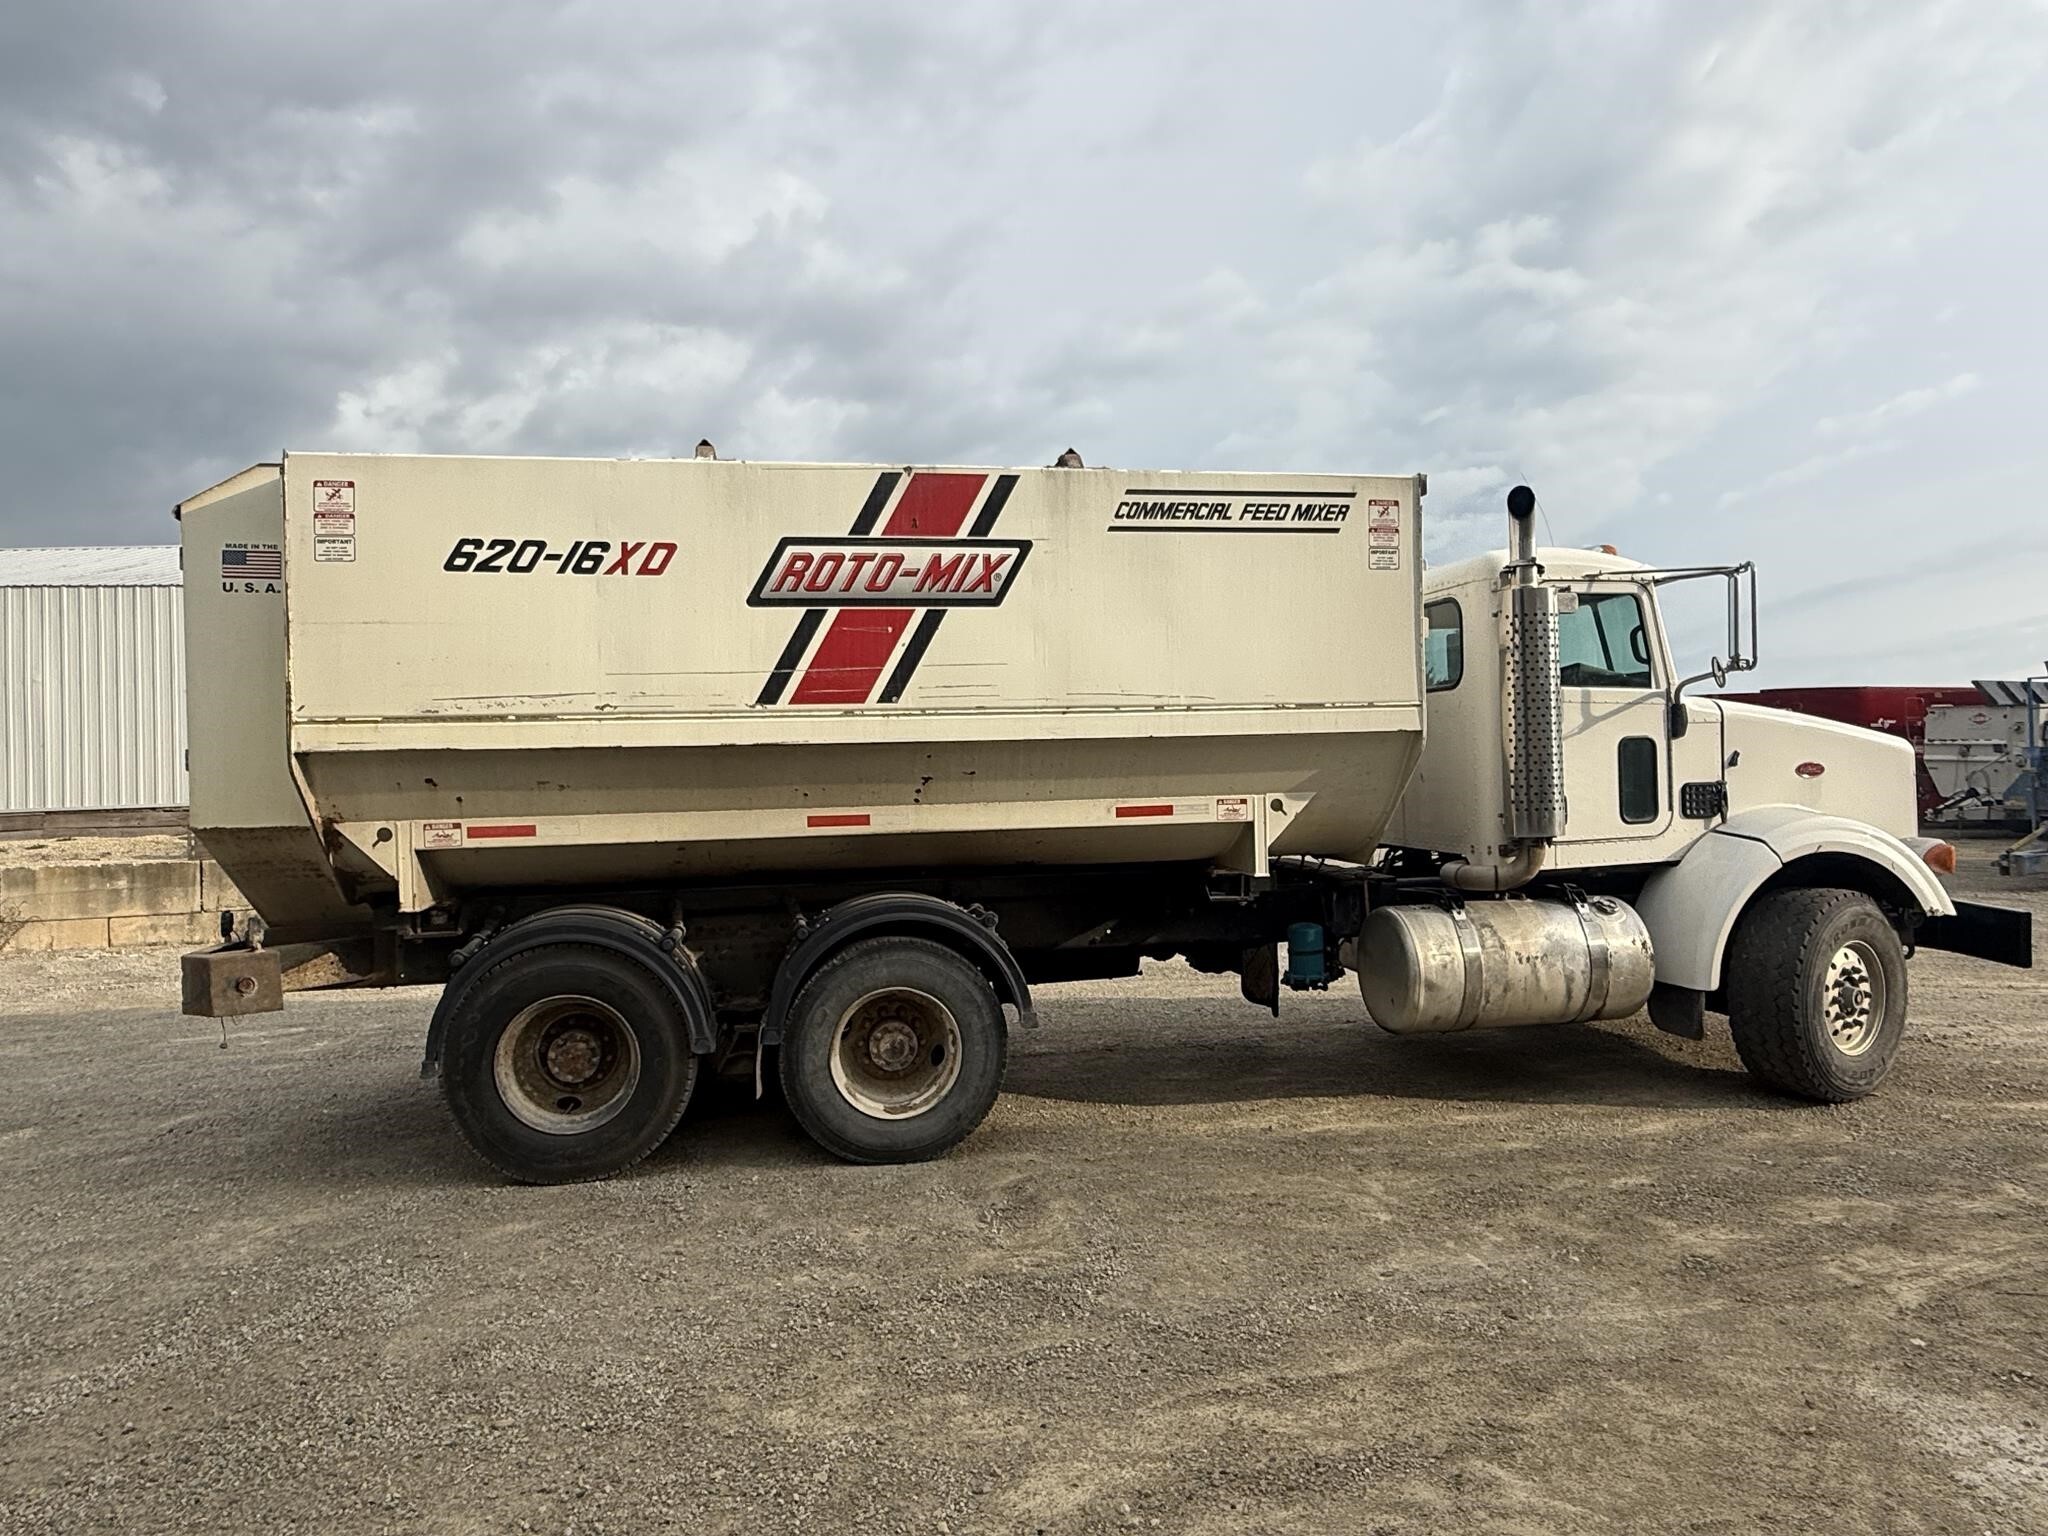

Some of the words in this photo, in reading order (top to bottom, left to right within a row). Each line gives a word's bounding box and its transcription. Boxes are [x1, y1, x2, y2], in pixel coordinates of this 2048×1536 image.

[1114, 501, 1233, 520] COMMERCIAL
[1239, 503, 1291, 521] FEED
[1291, 504, 1351, 522] MIXER
[262, 543, 279, 551] THE
[443, 538, 679, 576] 620-16XD
